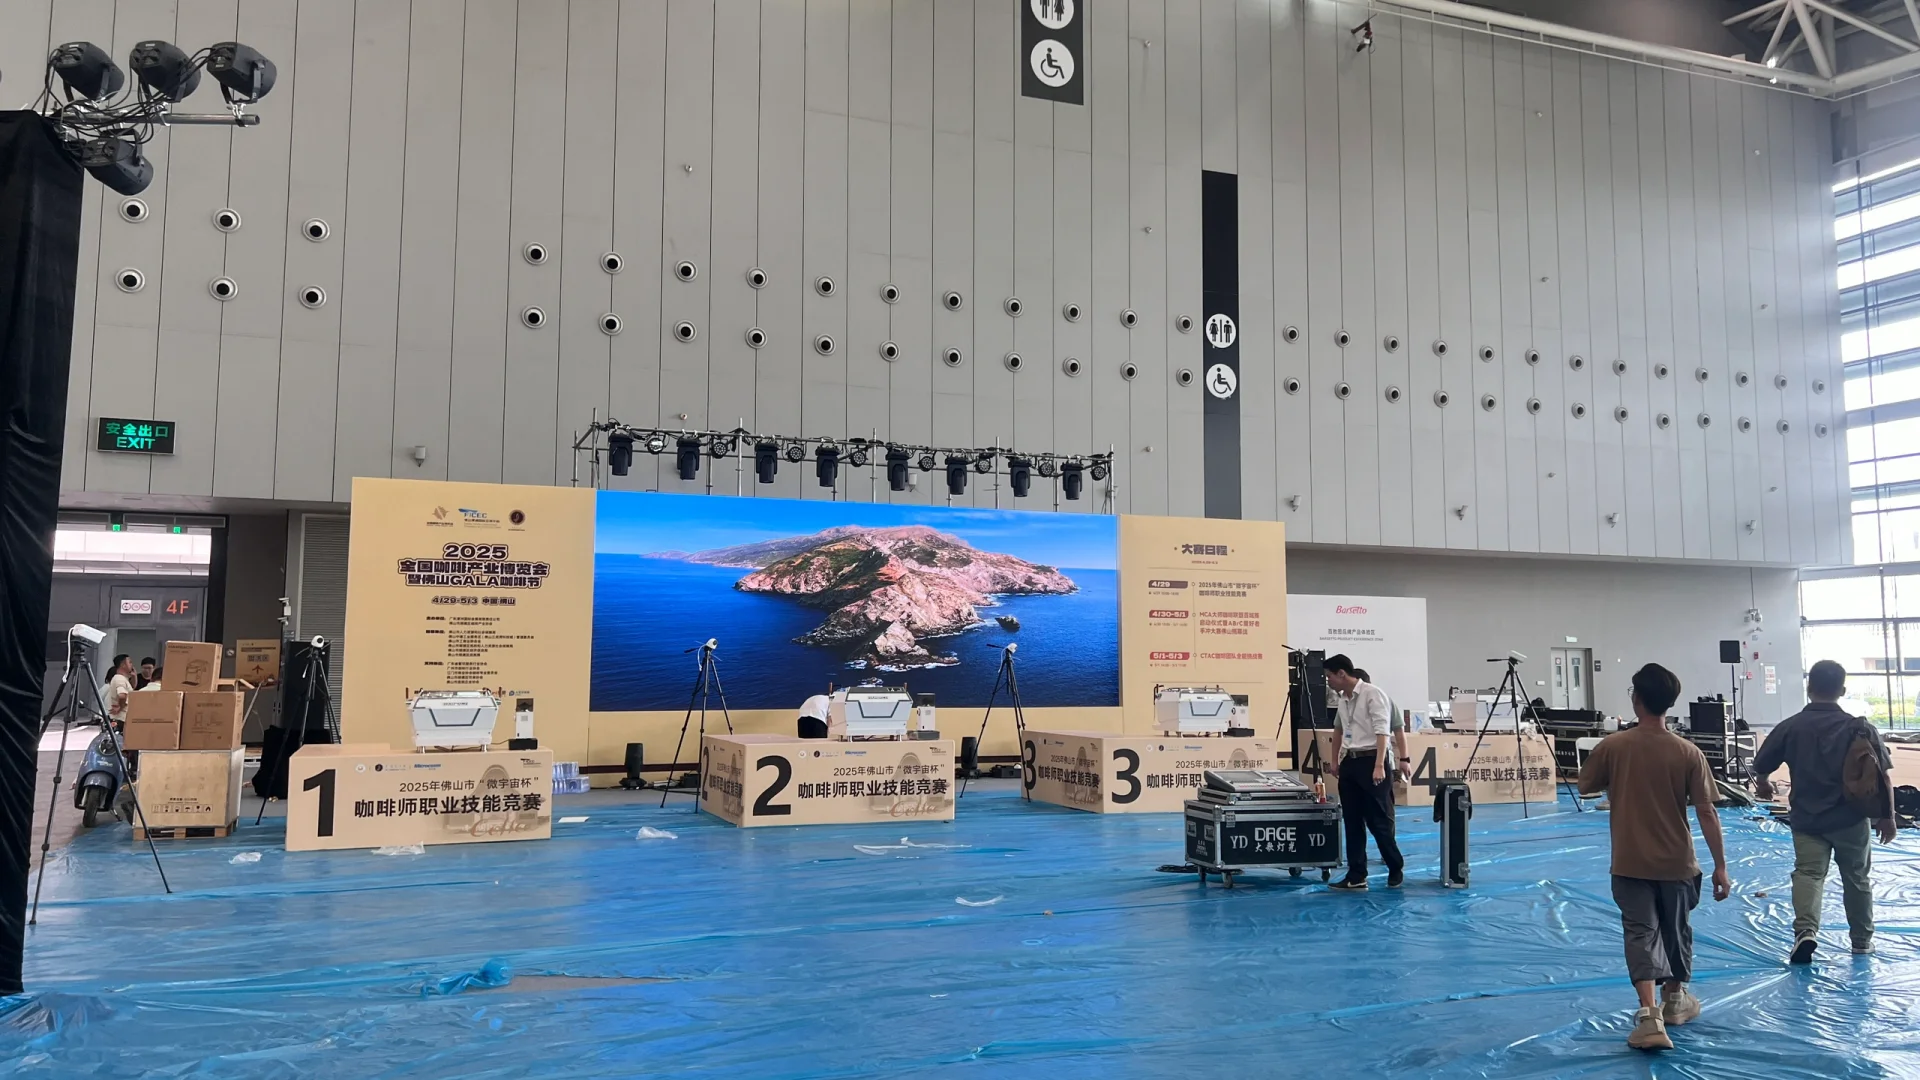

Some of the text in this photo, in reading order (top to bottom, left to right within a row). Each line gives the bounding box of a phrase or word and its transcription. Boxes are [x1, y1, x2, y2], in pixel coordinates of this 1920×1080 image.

[106, 422, 168, 437] 安全出口
[116, 437, 155, 449] EXIT
[443, 544, 508, 559] 2025
[1181, 544, 1228, 556] 大赛日程
[398, 559, 550, 576] 全国咖啡产业博览会
[406, 574, 542, 587] 暨佛山GALA咖啡节
[166, 600, 190, 615] 4F
[1336, 605, 1367, 614] Barsetto
[1025, 739, 1036, 790] 3
[1302, 739, 1324, 784] 4
[1411, 747, 1438, 796] 4
[701, 746, 711, 802] 2
[1038, 765, 1100, 789] 咖啡师职业技能竞赛
[1111, 748, 1142, 804] 3
[1146, 772, 1205, 789] 咖啡师职
[752, 755, 792, 816] 2
[798, 778, 947, 799] 咖啡师职业技能竞赛
[303, 768, 336, 837] 1
[354, 792, 541, 818] 咖啡师职业技能竞赛
[1230, 827, 1326, 849] YD DAGE YD
